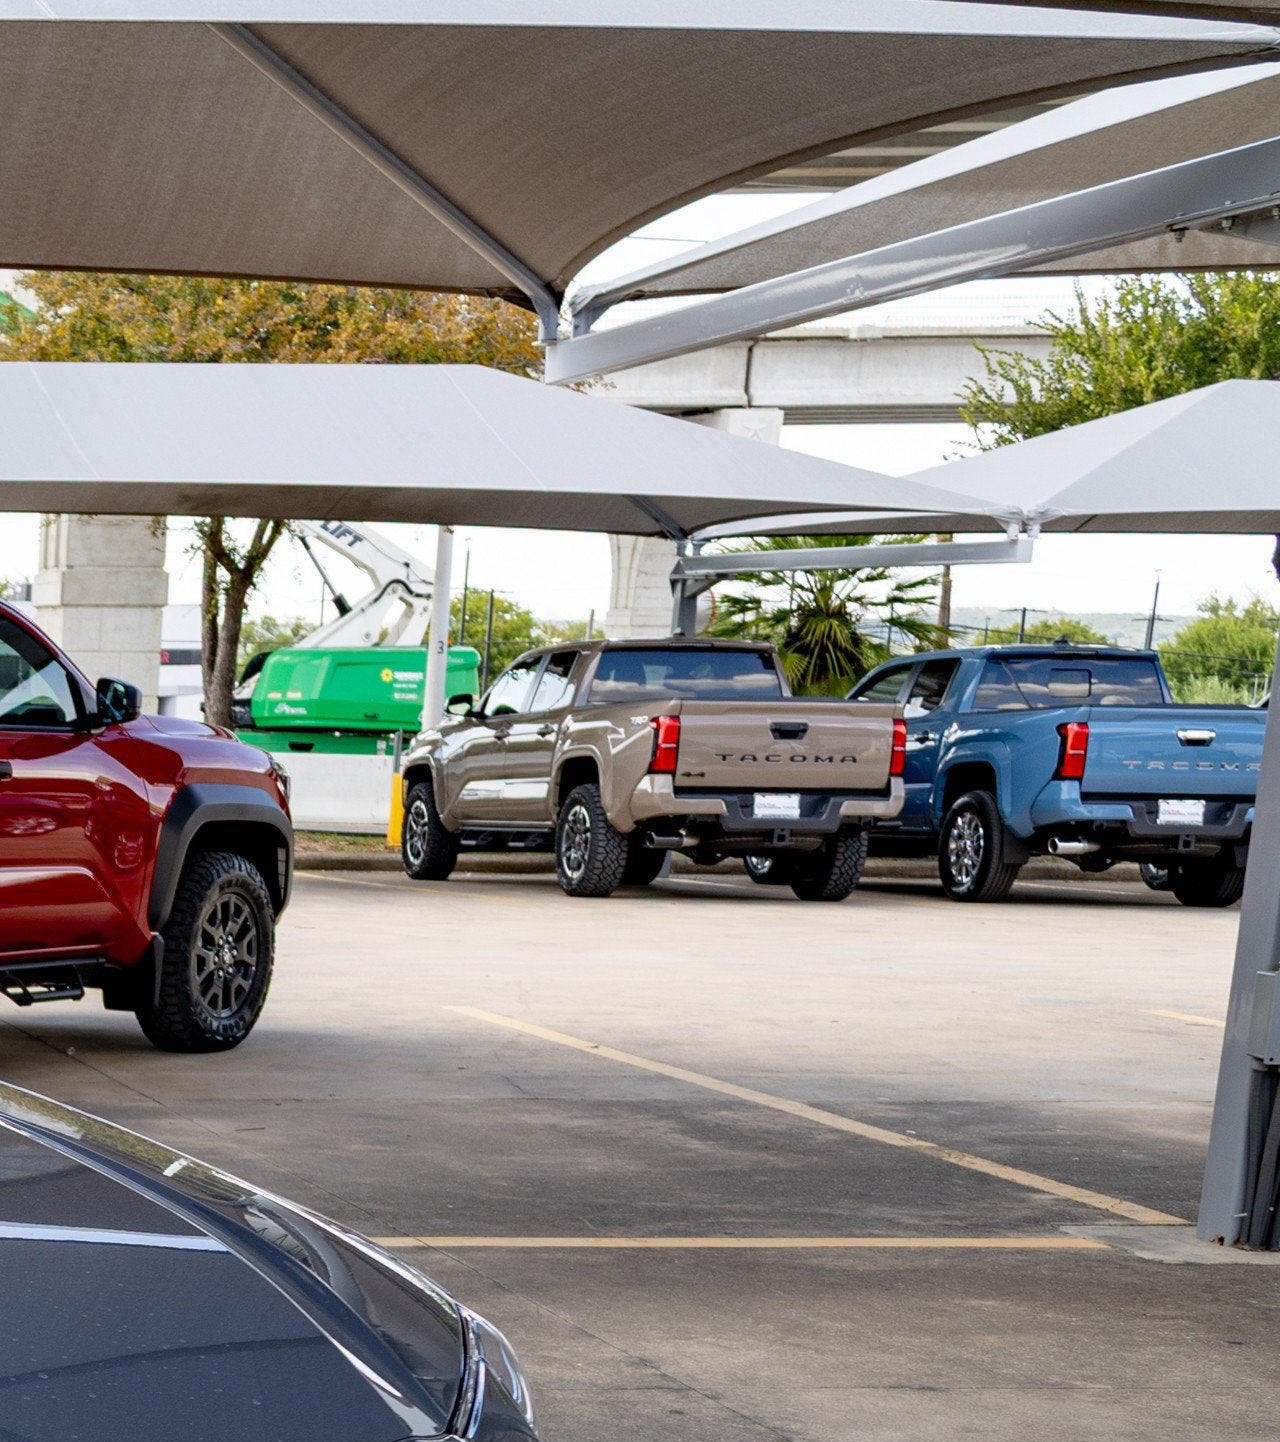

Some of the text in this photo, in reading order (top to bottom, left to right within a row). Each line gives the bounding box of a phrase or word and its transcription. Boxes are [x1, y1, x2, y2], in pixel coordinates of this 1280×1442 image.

[437, 640, 445, 654] 3
[714, 753, 858, 764] TACOMA
[1122, 760, 1262, 772] TACOMA
